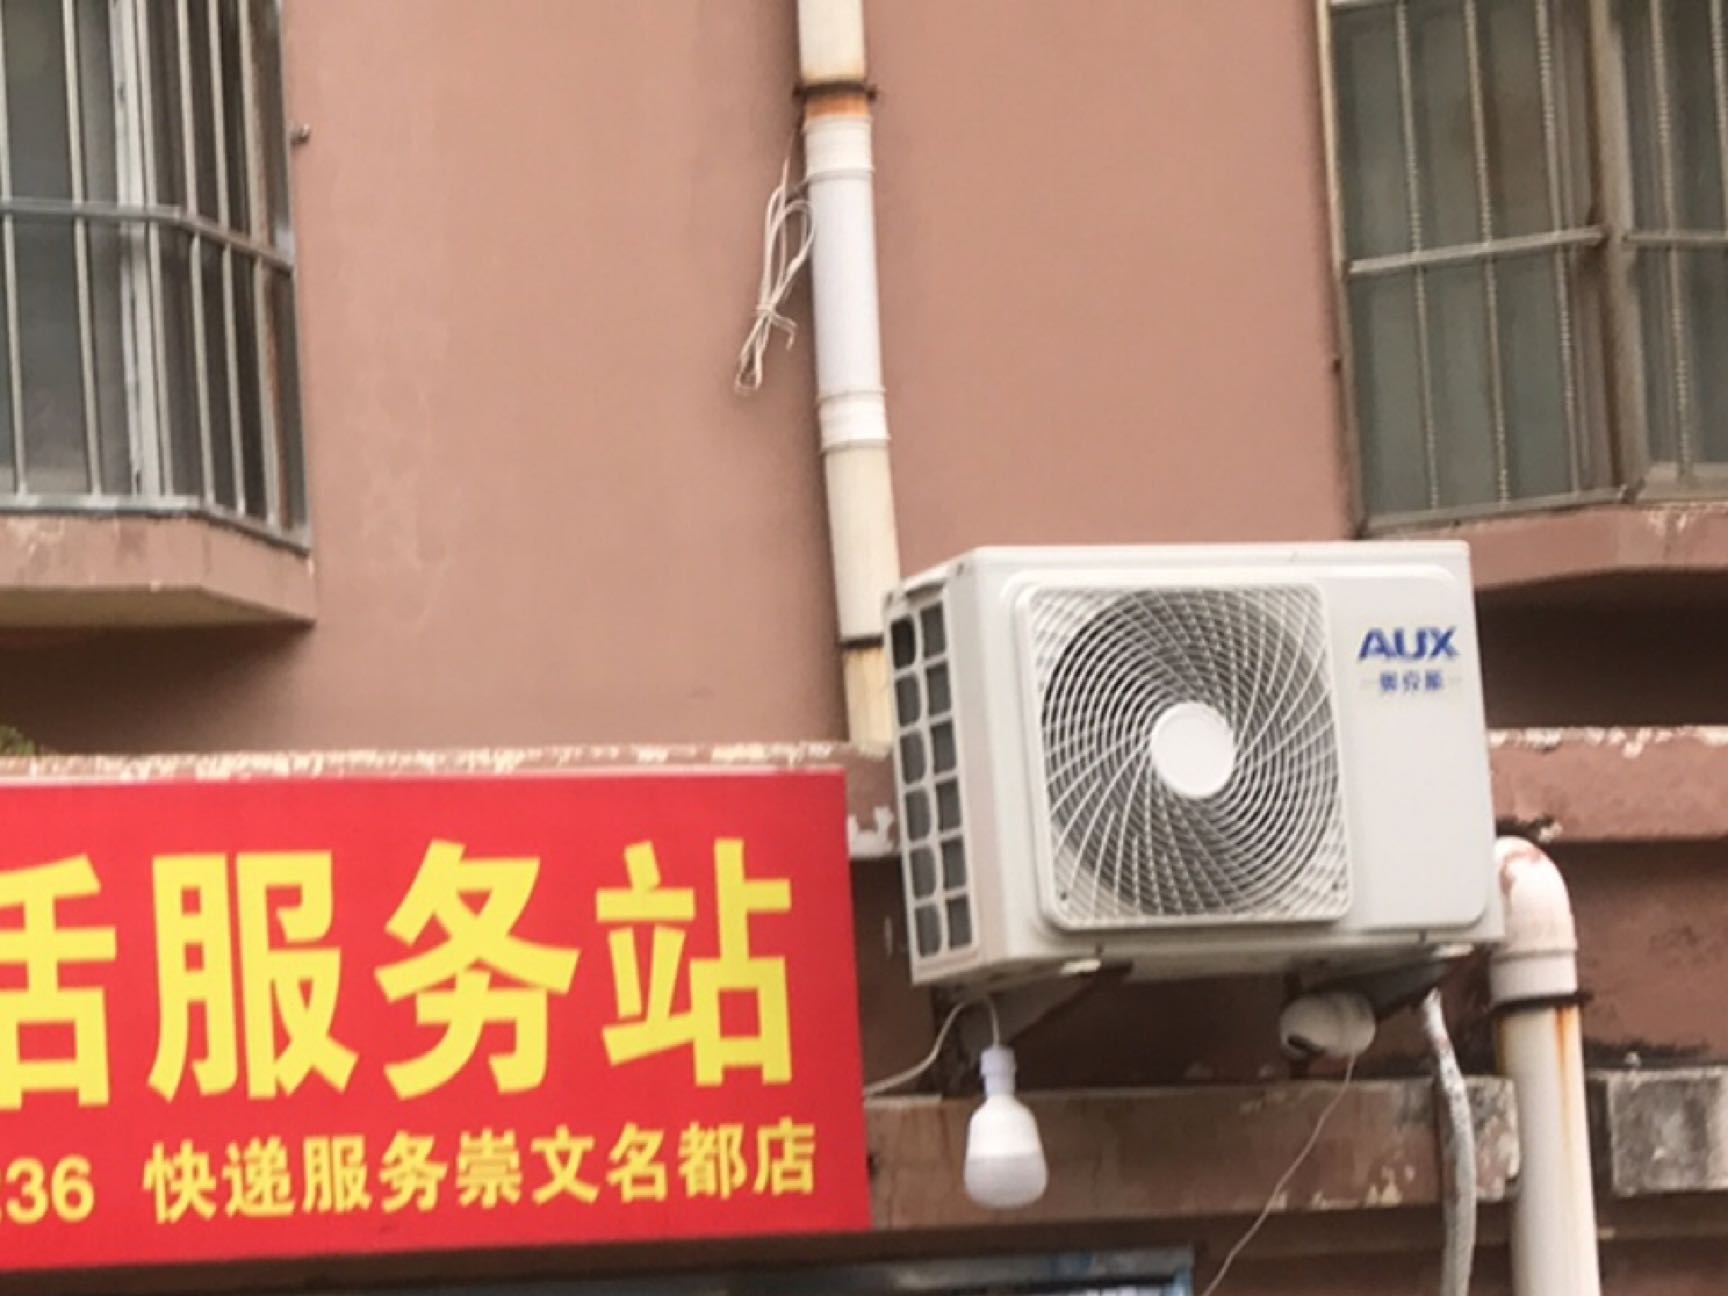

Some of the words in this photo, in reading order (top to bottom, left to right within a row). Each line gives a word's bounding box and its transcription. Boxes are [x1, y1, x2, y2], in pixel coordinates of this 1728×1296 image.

[1358, 627, 1460, 661] AUX
[145, 1119, 815, 1222] 快递服务崇文名都店
